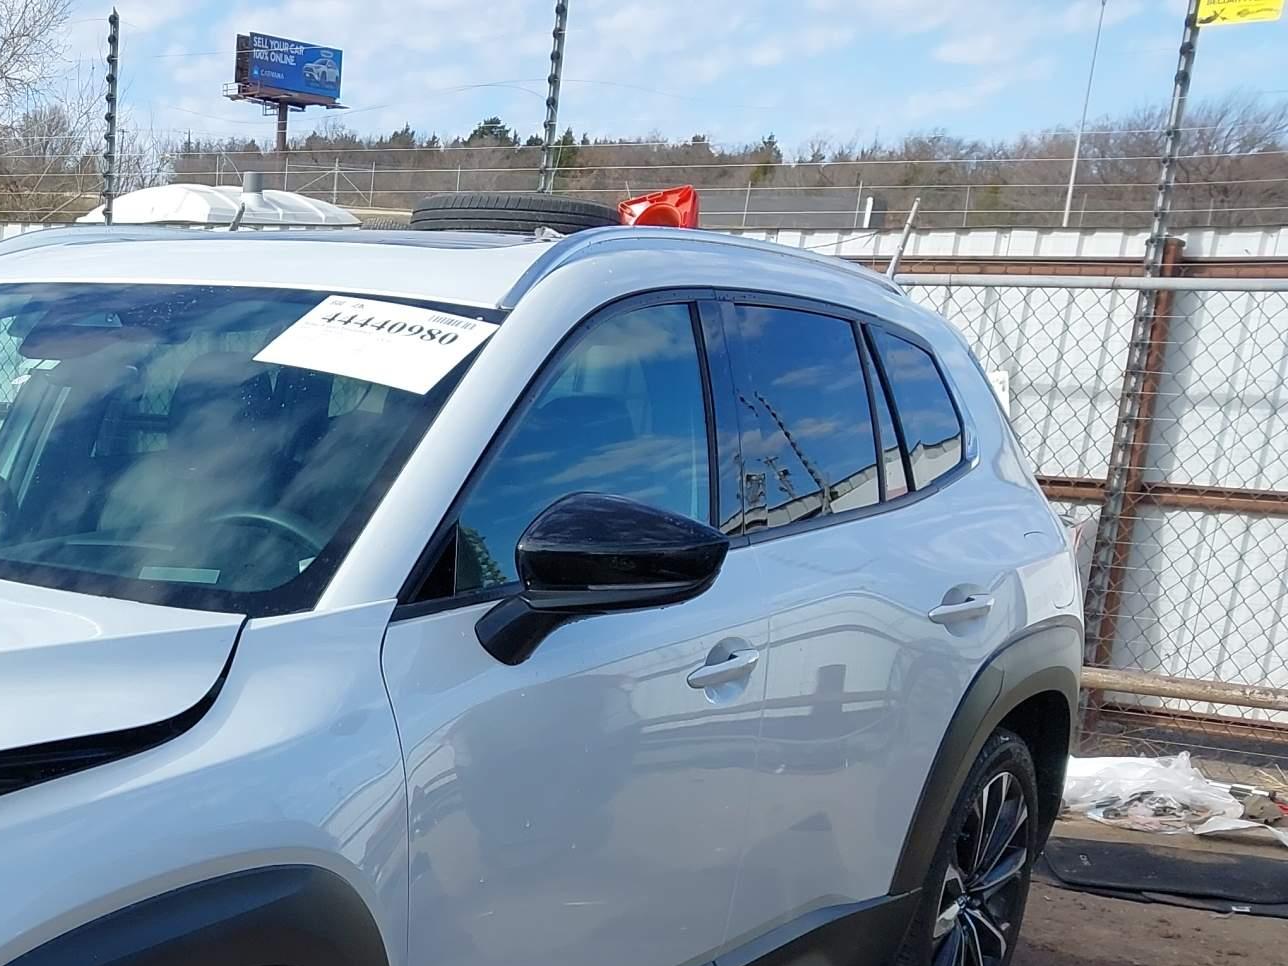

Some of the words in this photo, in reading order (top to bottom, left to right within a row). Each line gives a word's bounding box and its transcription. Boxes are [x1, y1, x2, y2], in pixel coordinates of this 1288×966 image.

[253, 36, 268, 48] SELL
[269, 39, 289, 52] YOUR
[289, 43, 305, 56] CAR
[253, 48, 269, 61] 100%
[320, 311, 459, 346] 44440980
